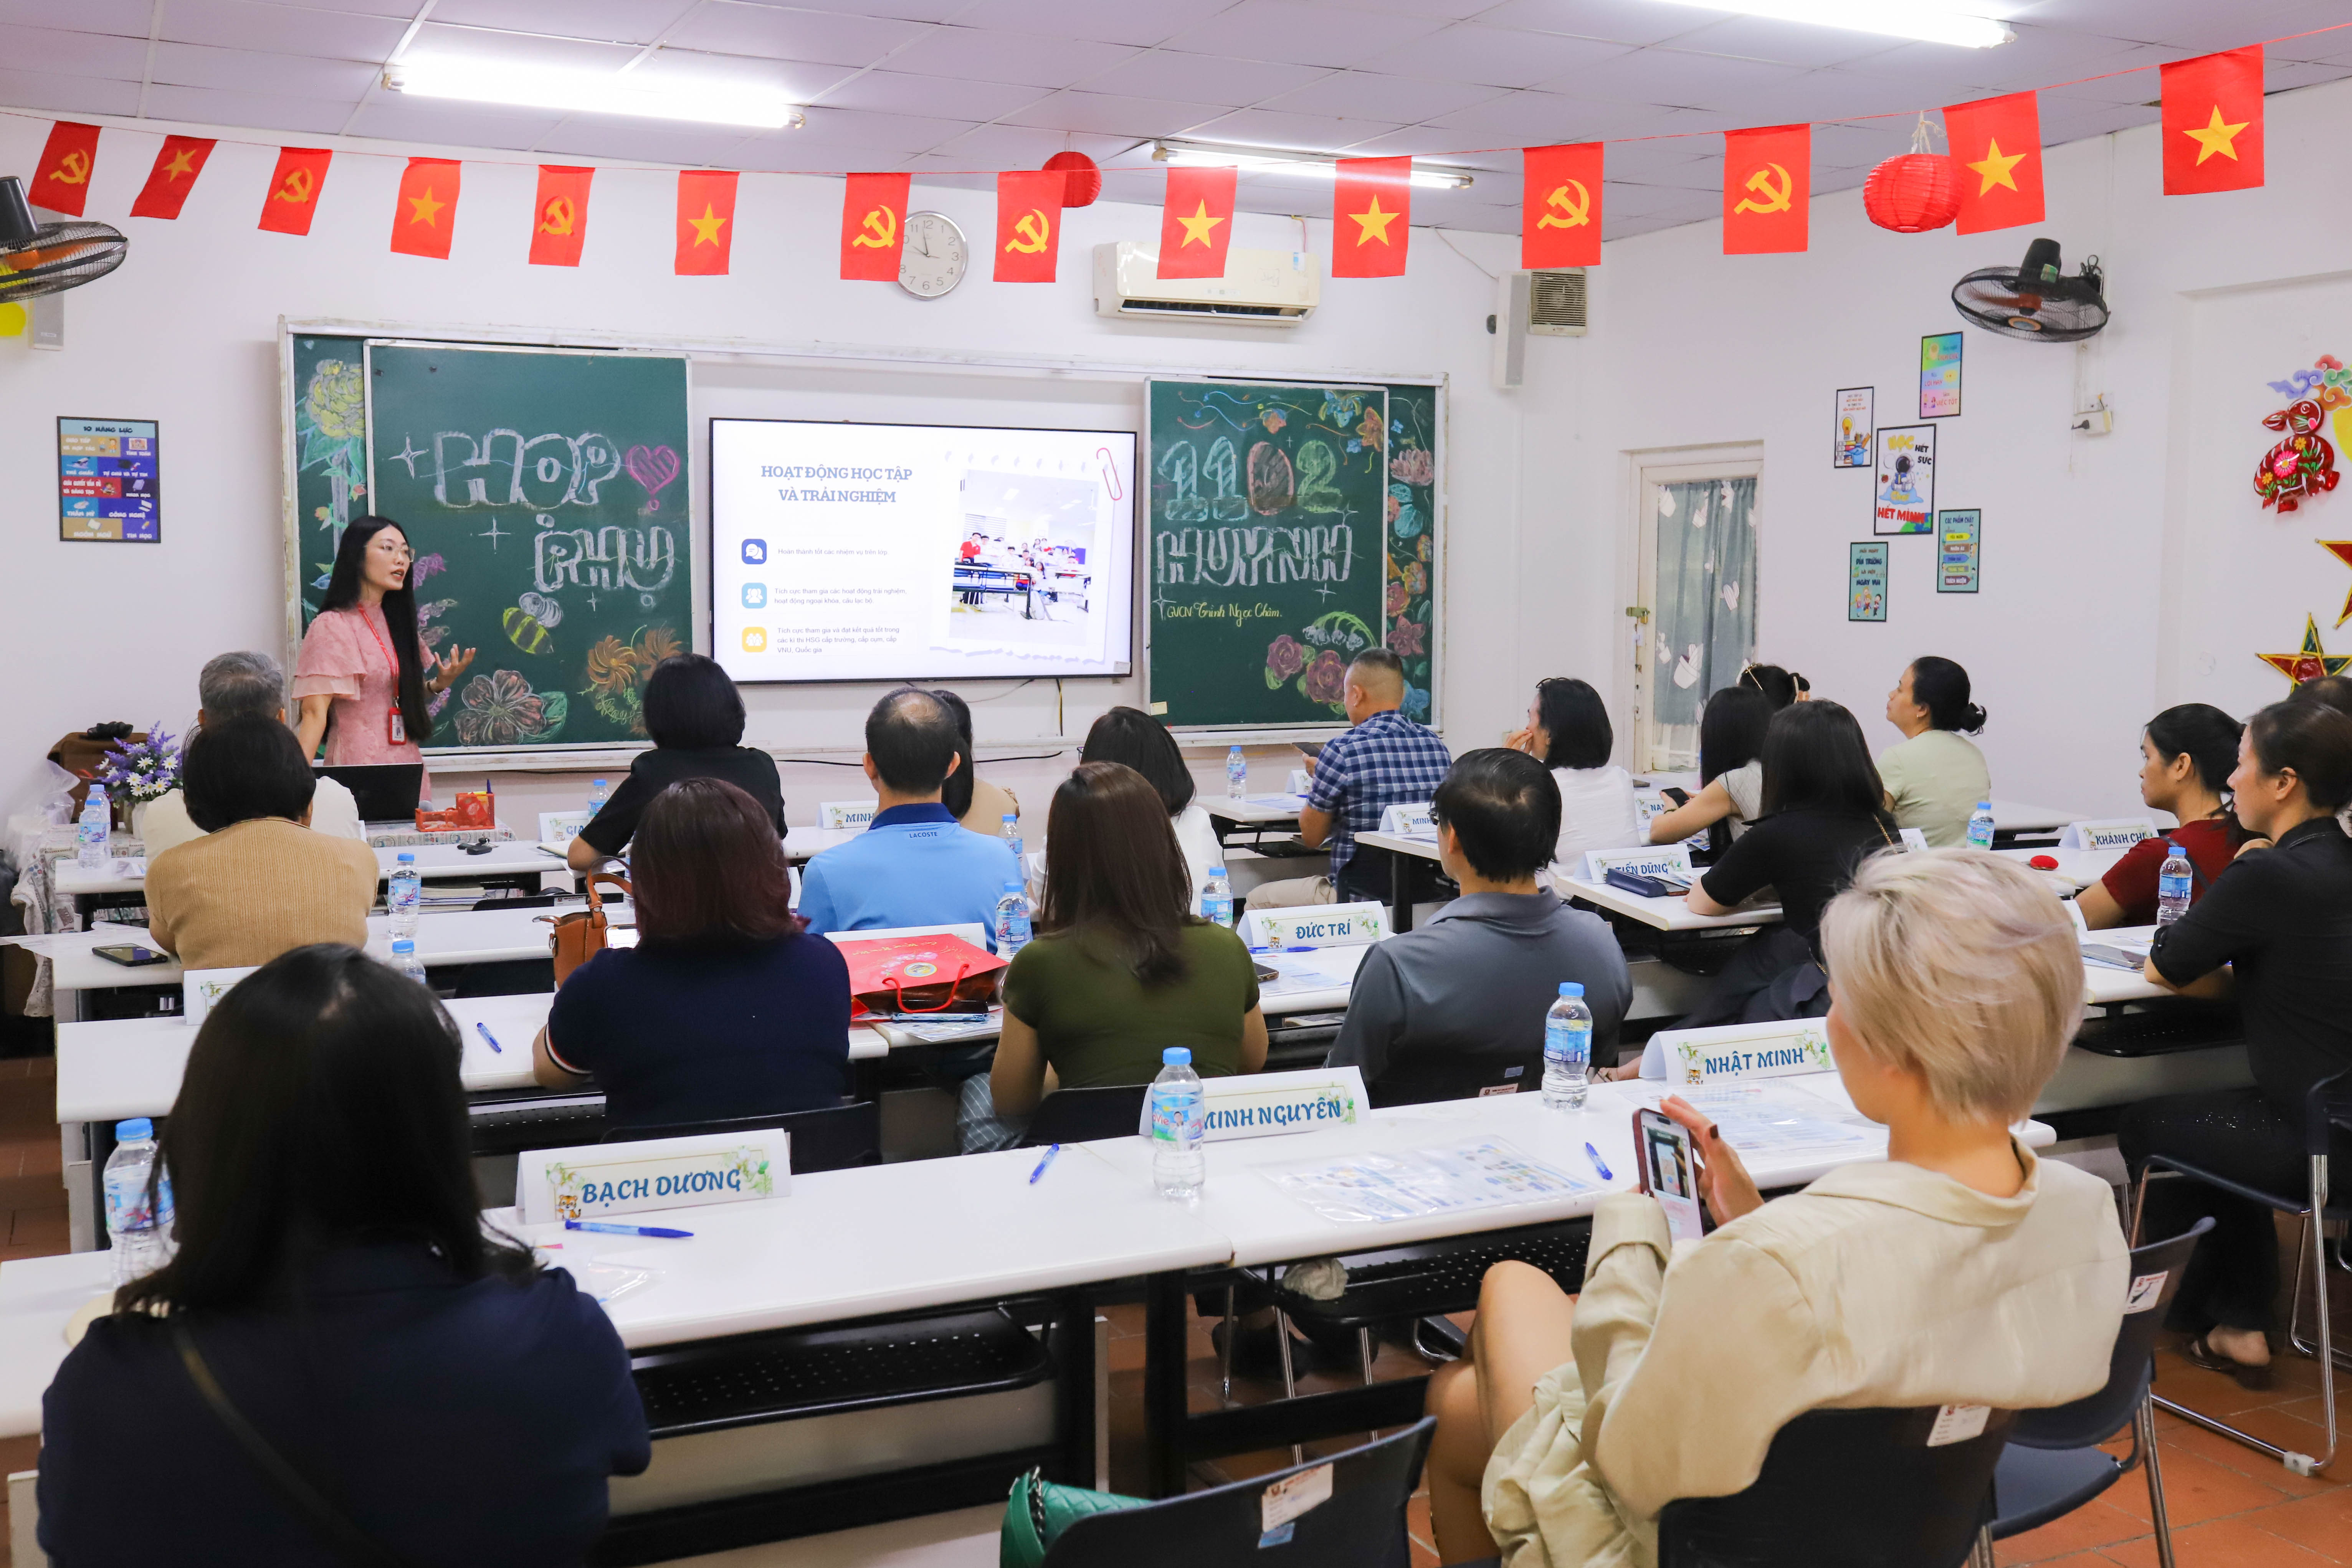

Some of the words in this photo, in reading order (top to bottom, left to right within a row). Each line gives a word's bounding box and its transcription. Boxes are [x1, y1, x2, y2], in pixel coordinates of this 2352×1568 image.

[911, 224, 918, 233] 11
[923, 220, 934, 229] 12
[940, 225, 944, 233] 1
[948, 236, 955, 246] 2
[951, 252, 959, 261] 3
[947, 267, 954, 275] 4
[909, 276, 916, 285] 7
[922, 281, 930, 290] 6
[936, 277, 944, 286] 5
[1888, 434, 1915, 452] HỌC
[761, 466, 803, 480] HOẠT
[805, 464, 848, 481] ĐỘNG
[851, 468, 883, 482] HỌC
[885, 466, 912, 482] TẬP
[778, 486, 798, 501] VÀ
[801, 486, 836, 501] TRẢI
[837, 488, 896, 505] NGHIỆM
[1878, 504, 1896, 519] HẾT
[1167, 606, 1192, 618] GVCN
[1229, 603, 1252, 627] Ngọc
[821, 636, 833, 644] cấp
[846, 813, 874, 823] MINH
[2095, 832, 2129, 845] KHÁNH
[1641, 862, 1668, 874] DŨNG
[1296, 922, 1324, 939] ĐỨC
[1327, 918, 1350, 936] TRÍ
[1706, 1051, 1753, 1076] NHẬT
[1757, 1047, 1804, 1068] MINH
[1258, 1097, 1341, 1126] NGUYÊN
[582, 1178, 649, 1208] BẠCH
[656, 1168, 741, 1196] DƯƠNG
